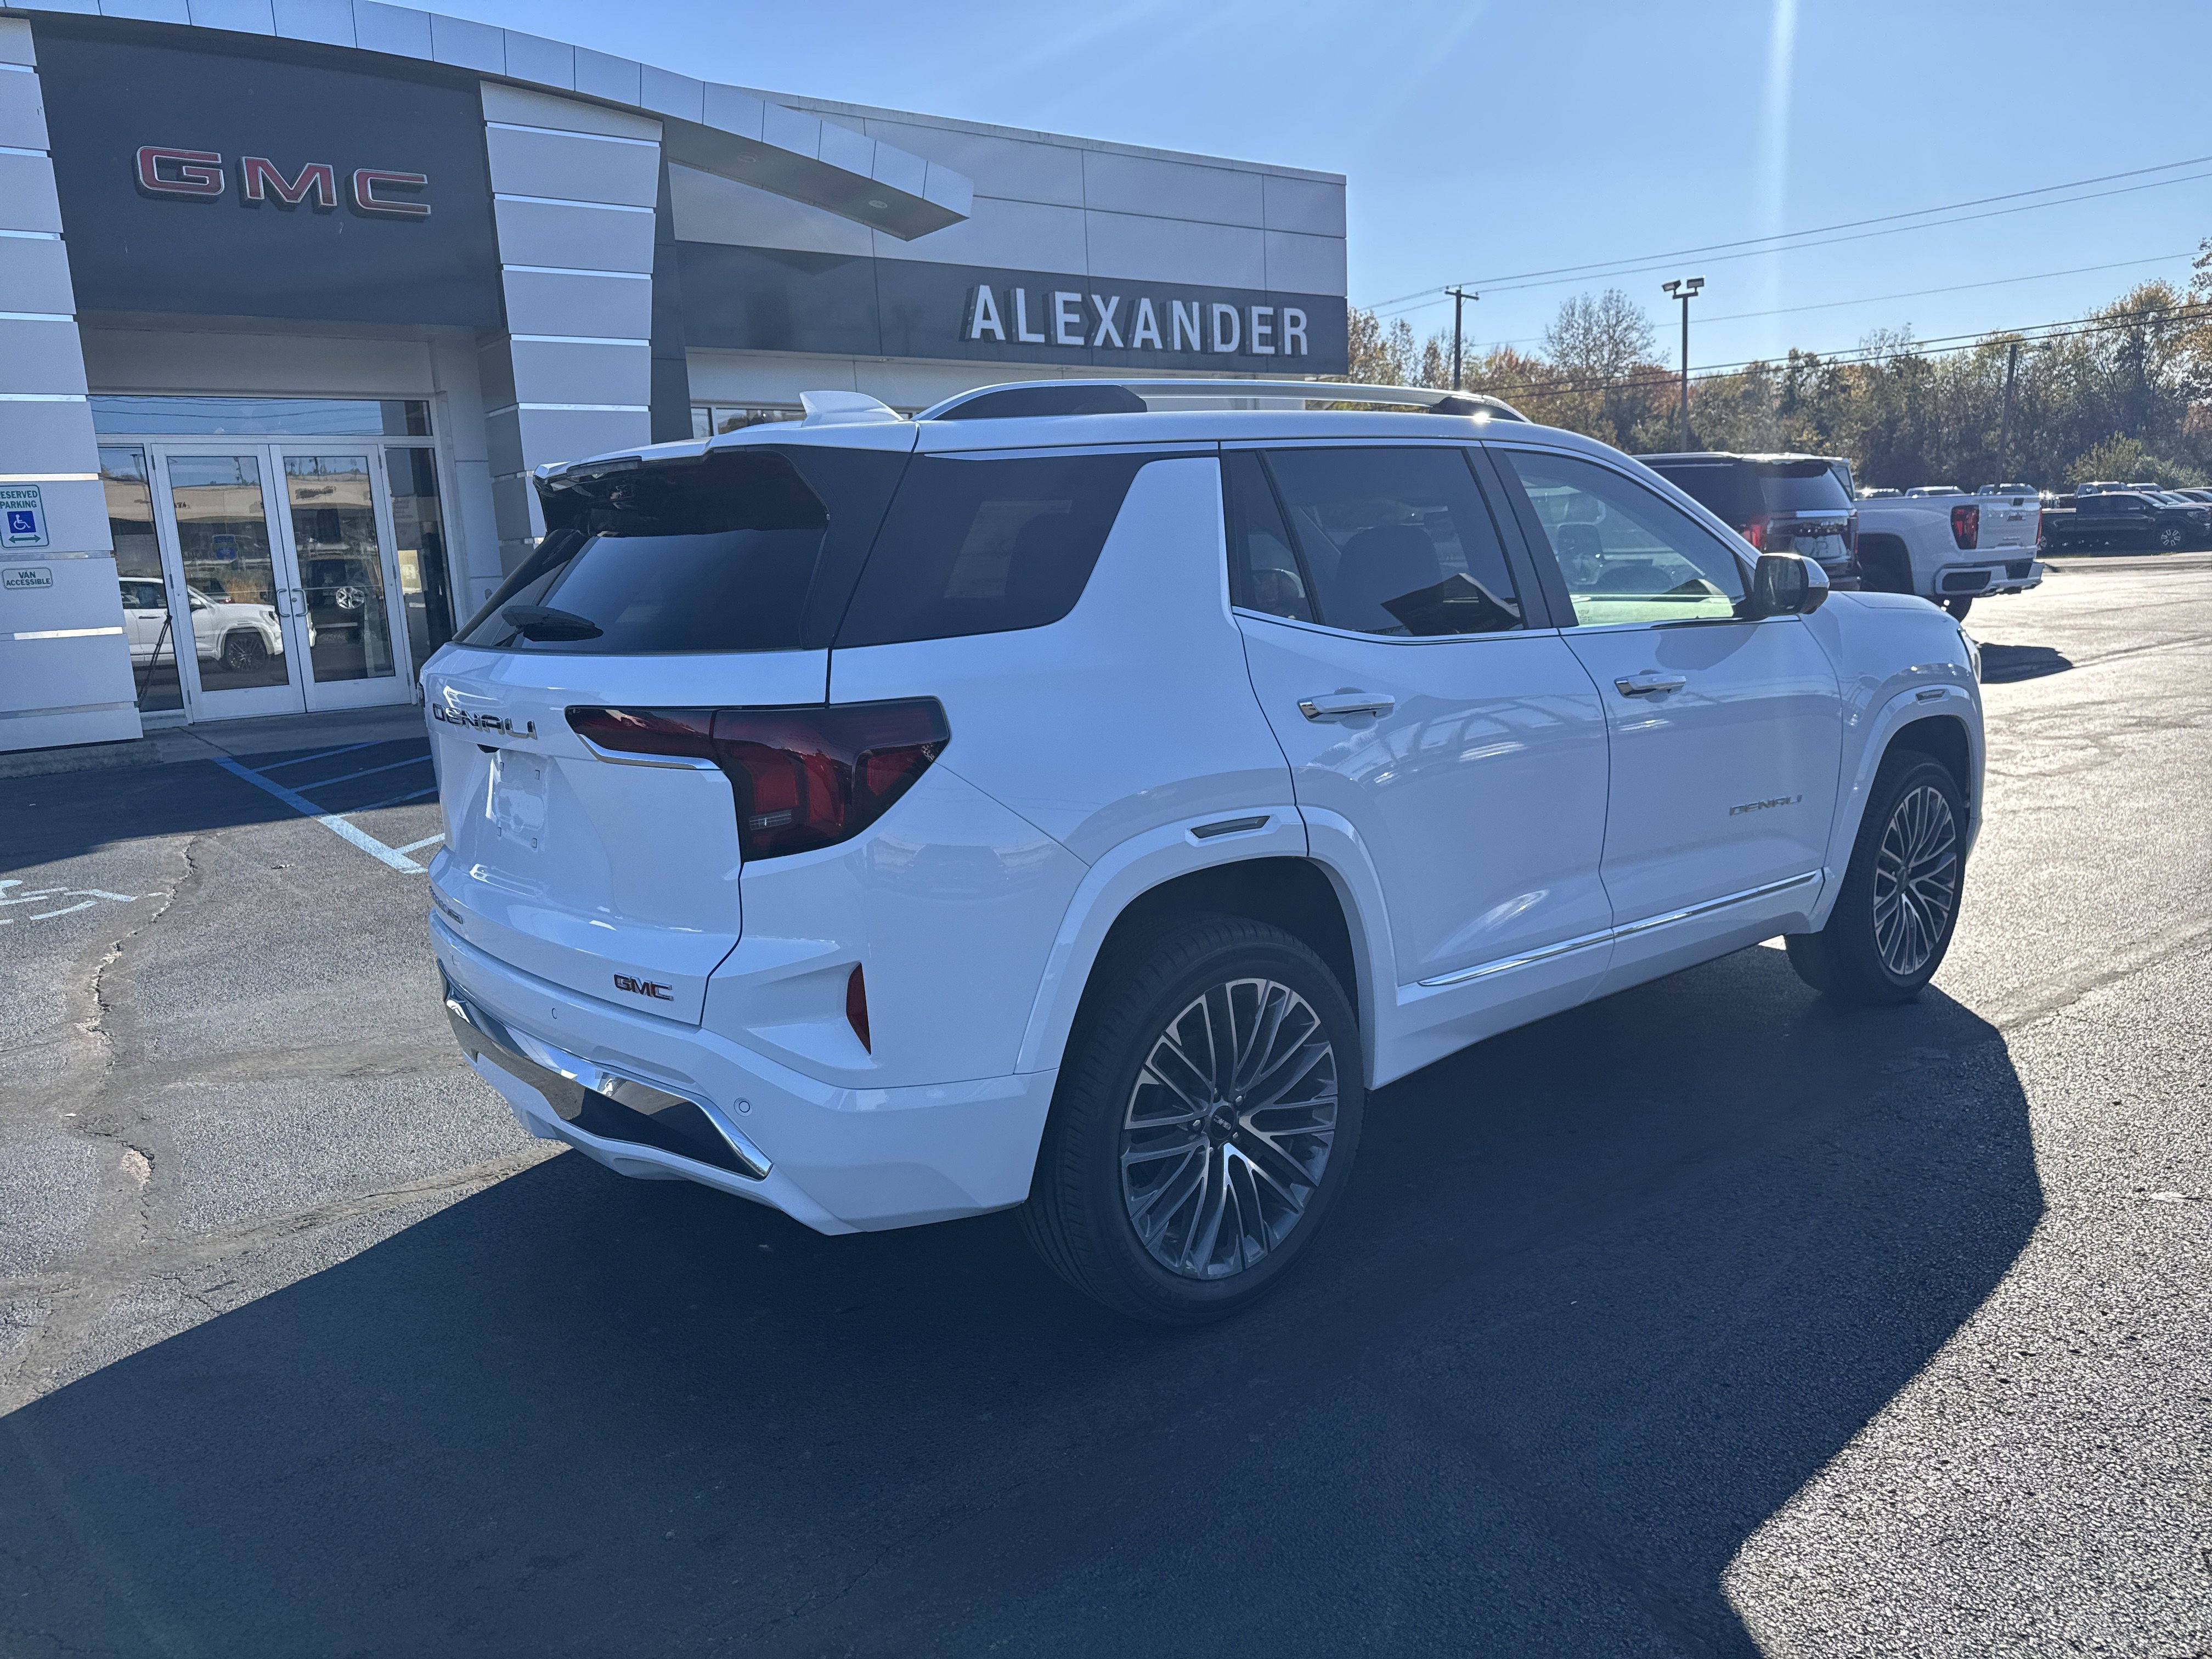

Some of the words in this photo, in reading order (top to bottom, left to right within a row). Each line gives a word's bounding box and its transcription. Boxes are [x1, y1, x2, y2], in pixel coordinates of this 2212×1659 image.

[136, 145, 432, 215] GMC
[969, 284, 1308, 356] ALEXANDER
[0, 490, 38, 499] ESERVED
[0, 500, 37, 509] PARKING
[6, 578, 52, 586] ACCESSIBLE
[432, 703, 538, 740] DENALI
[1729, 794, 1803, 816] DENALI
[613, 972, 674, 1002] GMC
